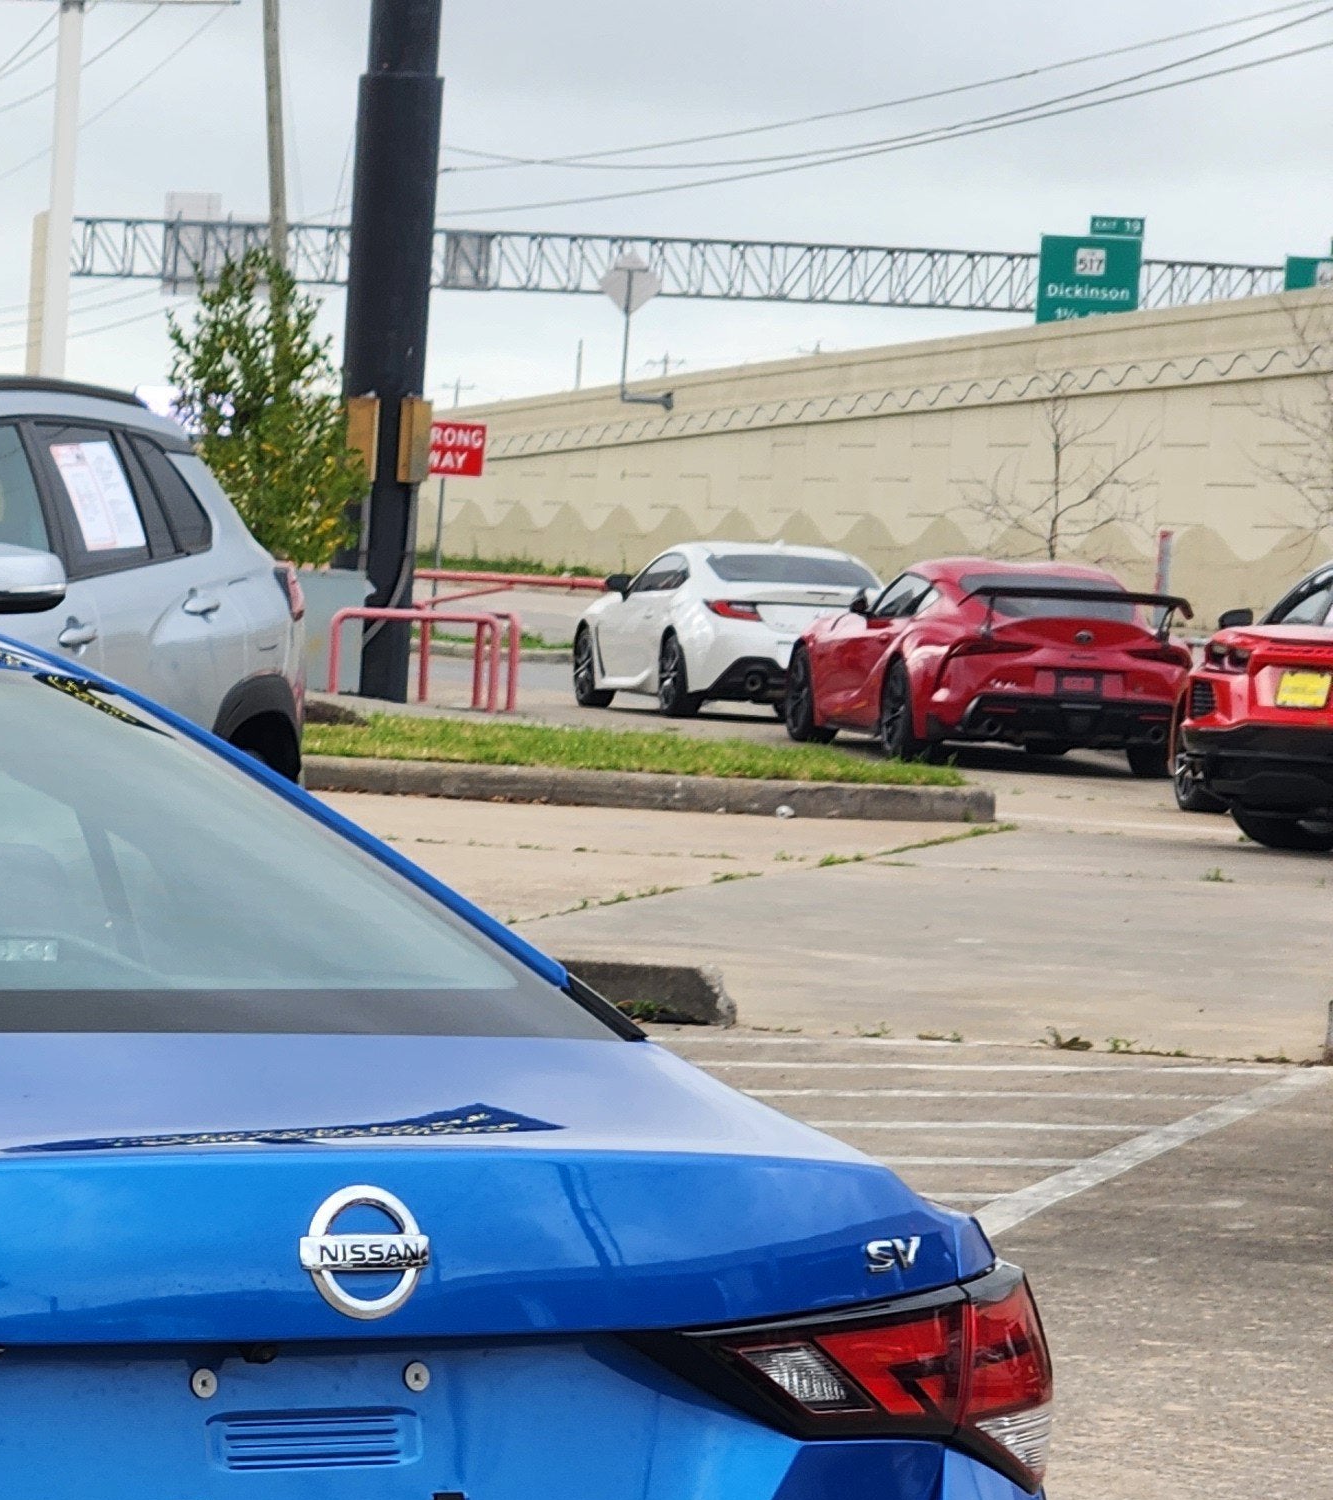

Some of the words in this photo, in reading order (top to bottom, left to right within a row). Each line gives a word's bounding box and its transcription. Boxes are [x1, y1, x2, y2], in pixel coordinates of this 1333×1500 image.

[1078, 258, 1103, 272] 517
[1047, 282, 1130, 301] Dickinson
[430, 426, 483, 449] RONG
[319, 1243, 419, 1263] NISSAN
[866, 1236, 922, 1273] SV
